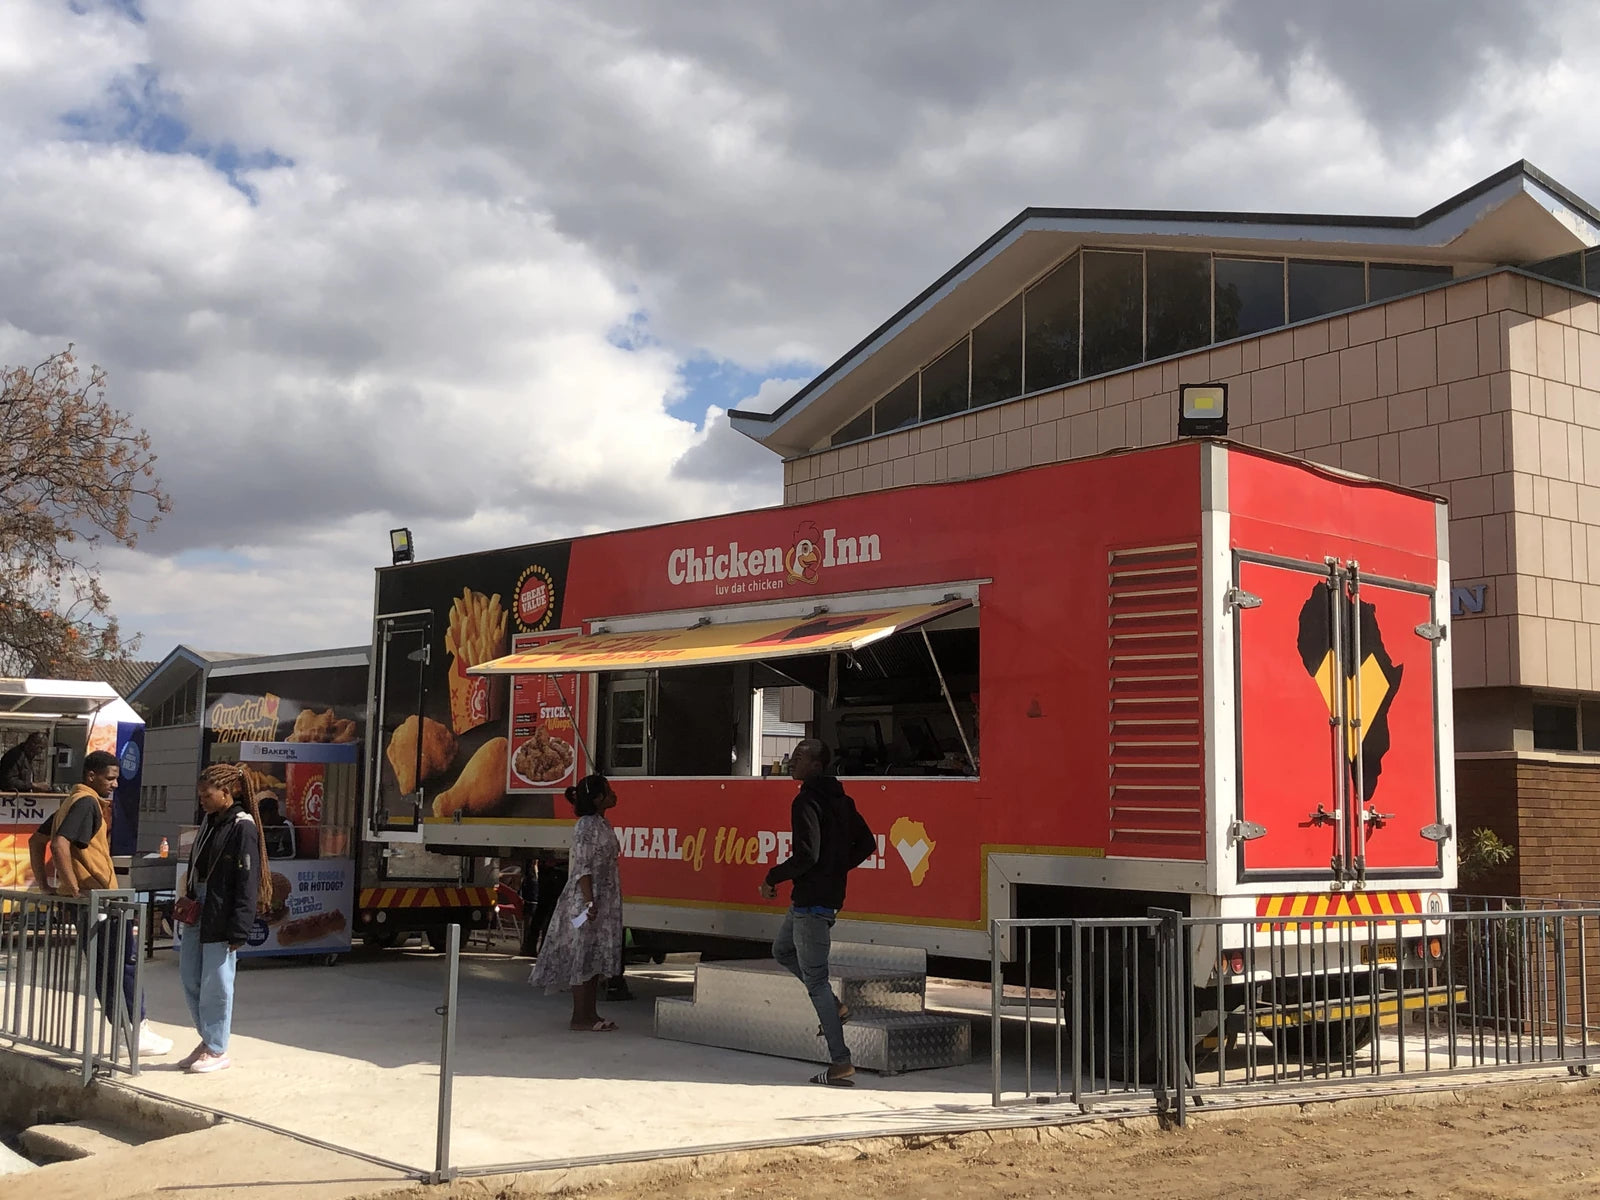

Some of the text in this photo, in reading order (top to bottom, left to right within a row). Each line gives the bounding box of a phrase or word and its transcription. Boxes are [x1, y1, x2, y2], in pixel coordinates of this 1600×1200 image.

[668, 528, 881, 585] Chicken Inn
[521, 584, 545, 602] GREAT
[715, 579, 783, 595] luv dat chicken
[522, 595, 546, 612] VALUE
[11, 809, 44, 818] INN
[613, 826, 683, 860] MEAL
[299, 882, 309, 891] OR
